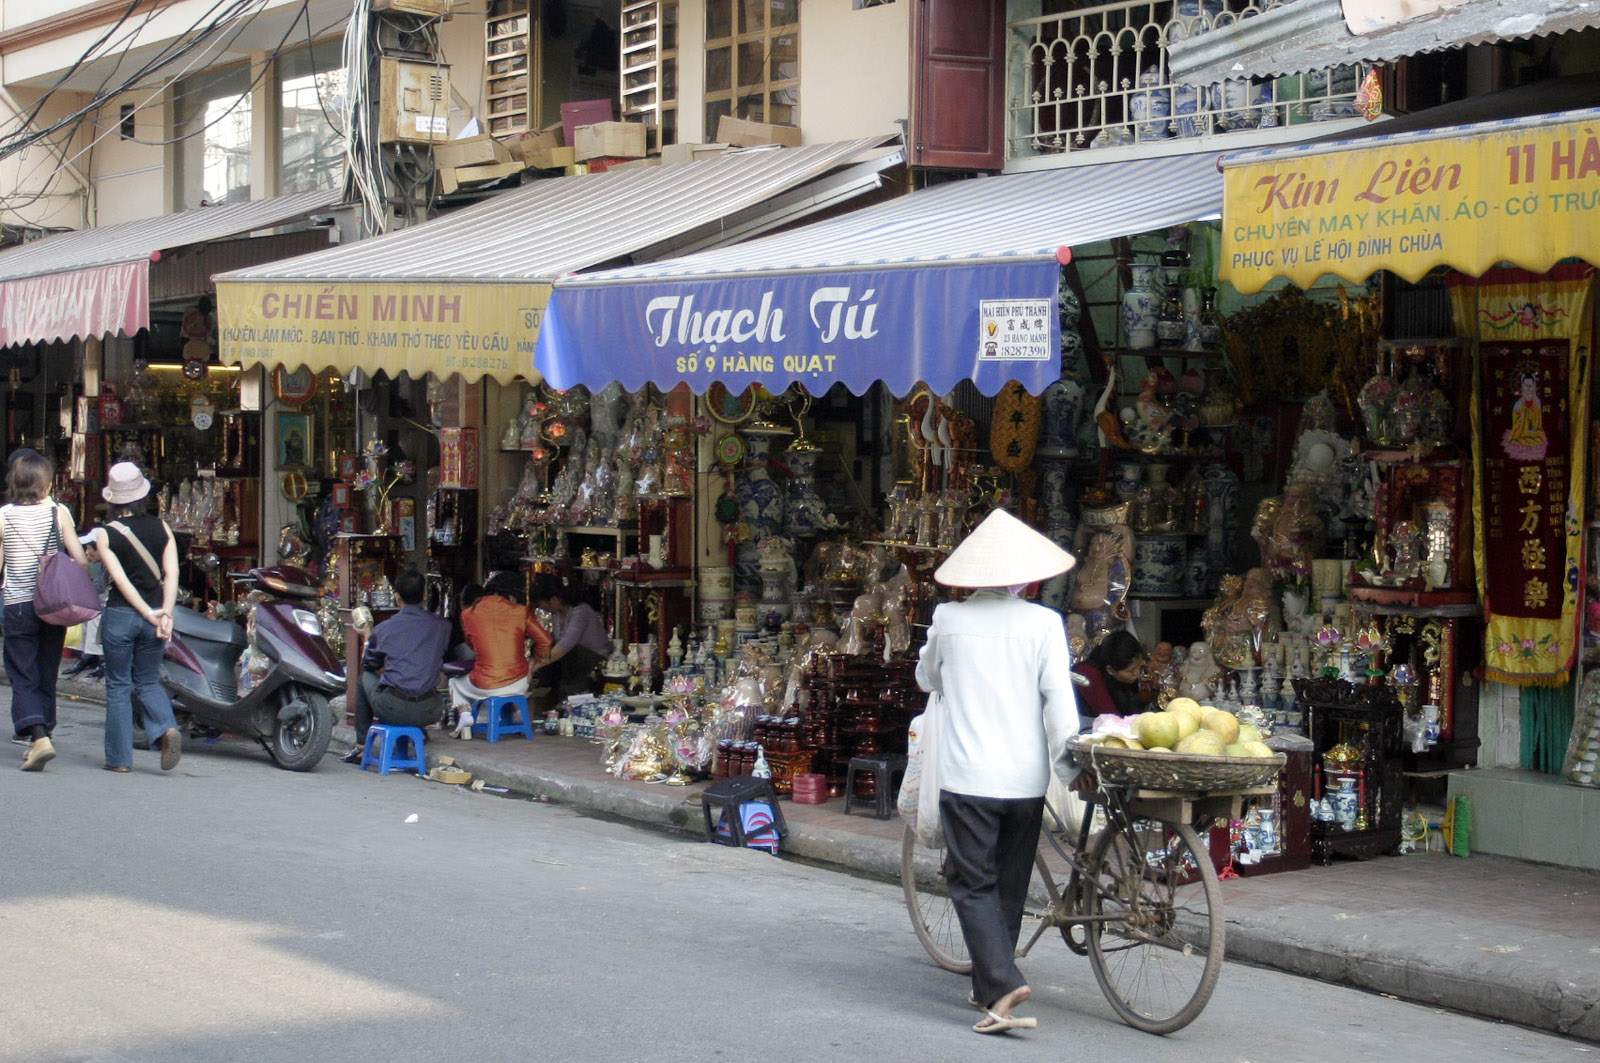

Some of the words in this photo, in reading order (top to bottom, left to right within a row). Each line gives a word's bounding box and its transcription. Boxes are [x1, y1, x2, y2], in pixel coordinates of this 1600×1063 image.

[1254, 171, 1339, 213] Kim
[1354, 156, 1461, 204] Liên
[1506, 143, 1536, 185] 11
[1234, 216, 1311, 242] CHUYÊN
[1319, 213, 1369, 233] MAY
[1453, 195, 1488, 221] ÁO
[1548, 188, 1600, 213] TRƯ
[1232, 250, 1275, 271] PHỤC
[1282, 248, 1299, 268] VỤ
[1327, 239, 1352, 263] HỘI
[1357, 235, 1392, 258] ĐÌNH
[1400, 229, 1443, 253] CHÙA
[262, 287, 358, 321] CHIẾN
[372, 294, 462, 323] MINH
[645, 291, 786, 353] Thạch
[809, 286, 879, 344] Tú
[424, 334, 451, 349] THEO
[456, 331, 479, 350] YÊU
[676, 350, 701, 373] SỐ
[706, 357, 716, 373] 9
[723, 352, 774, 373] HÀNG
[783, 355, 836, 377] QUẠT
